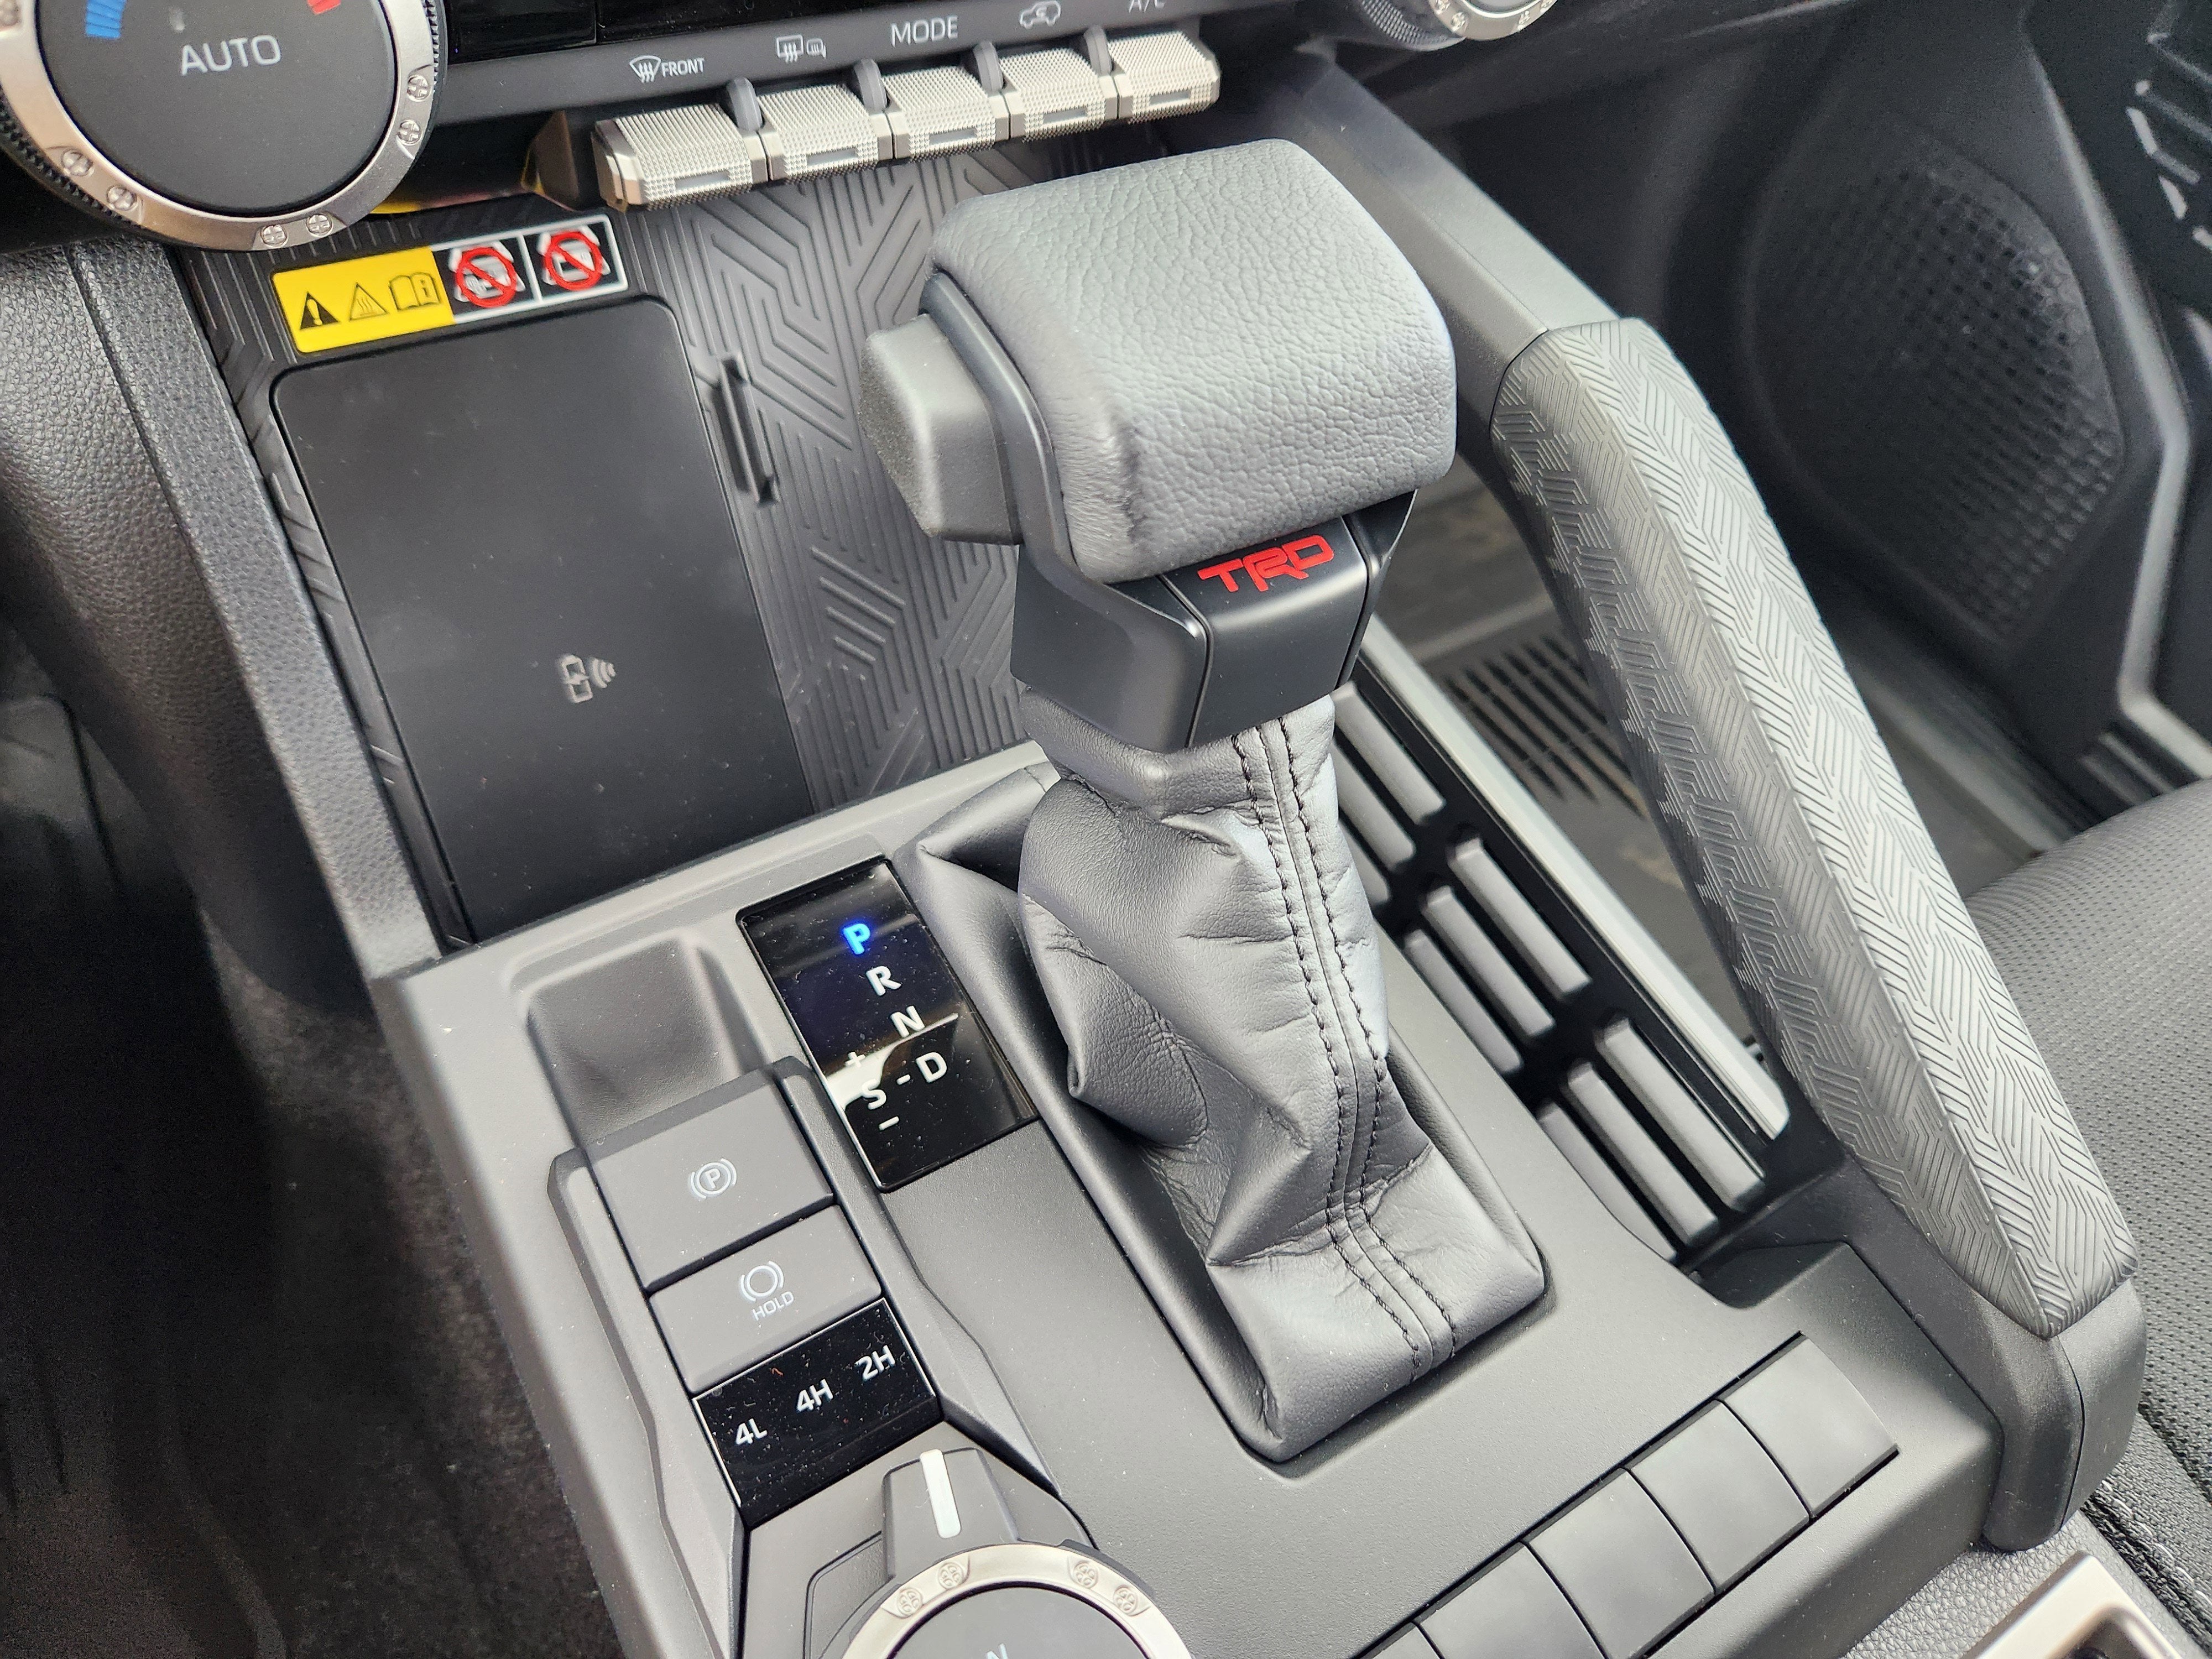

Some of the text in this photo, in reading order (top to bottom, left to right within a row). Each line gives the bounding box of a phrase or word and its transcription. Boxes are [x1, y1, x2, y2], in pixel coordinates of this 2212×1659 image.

[891, 15, 958, 47] MODE
[181, 34, 281, 76] AUTO
[662, 58, 705, 77] FRONT
[1197, 535, 1334, 592] TRD
[843, 922, 870, 955] P
[866, 966, 901, 996] R
[890, 1006, 926, 1037] N
[752, 1291, 795, 1321] HOLD
[735, 1345, 896, 1446] 4L 4H 2H
